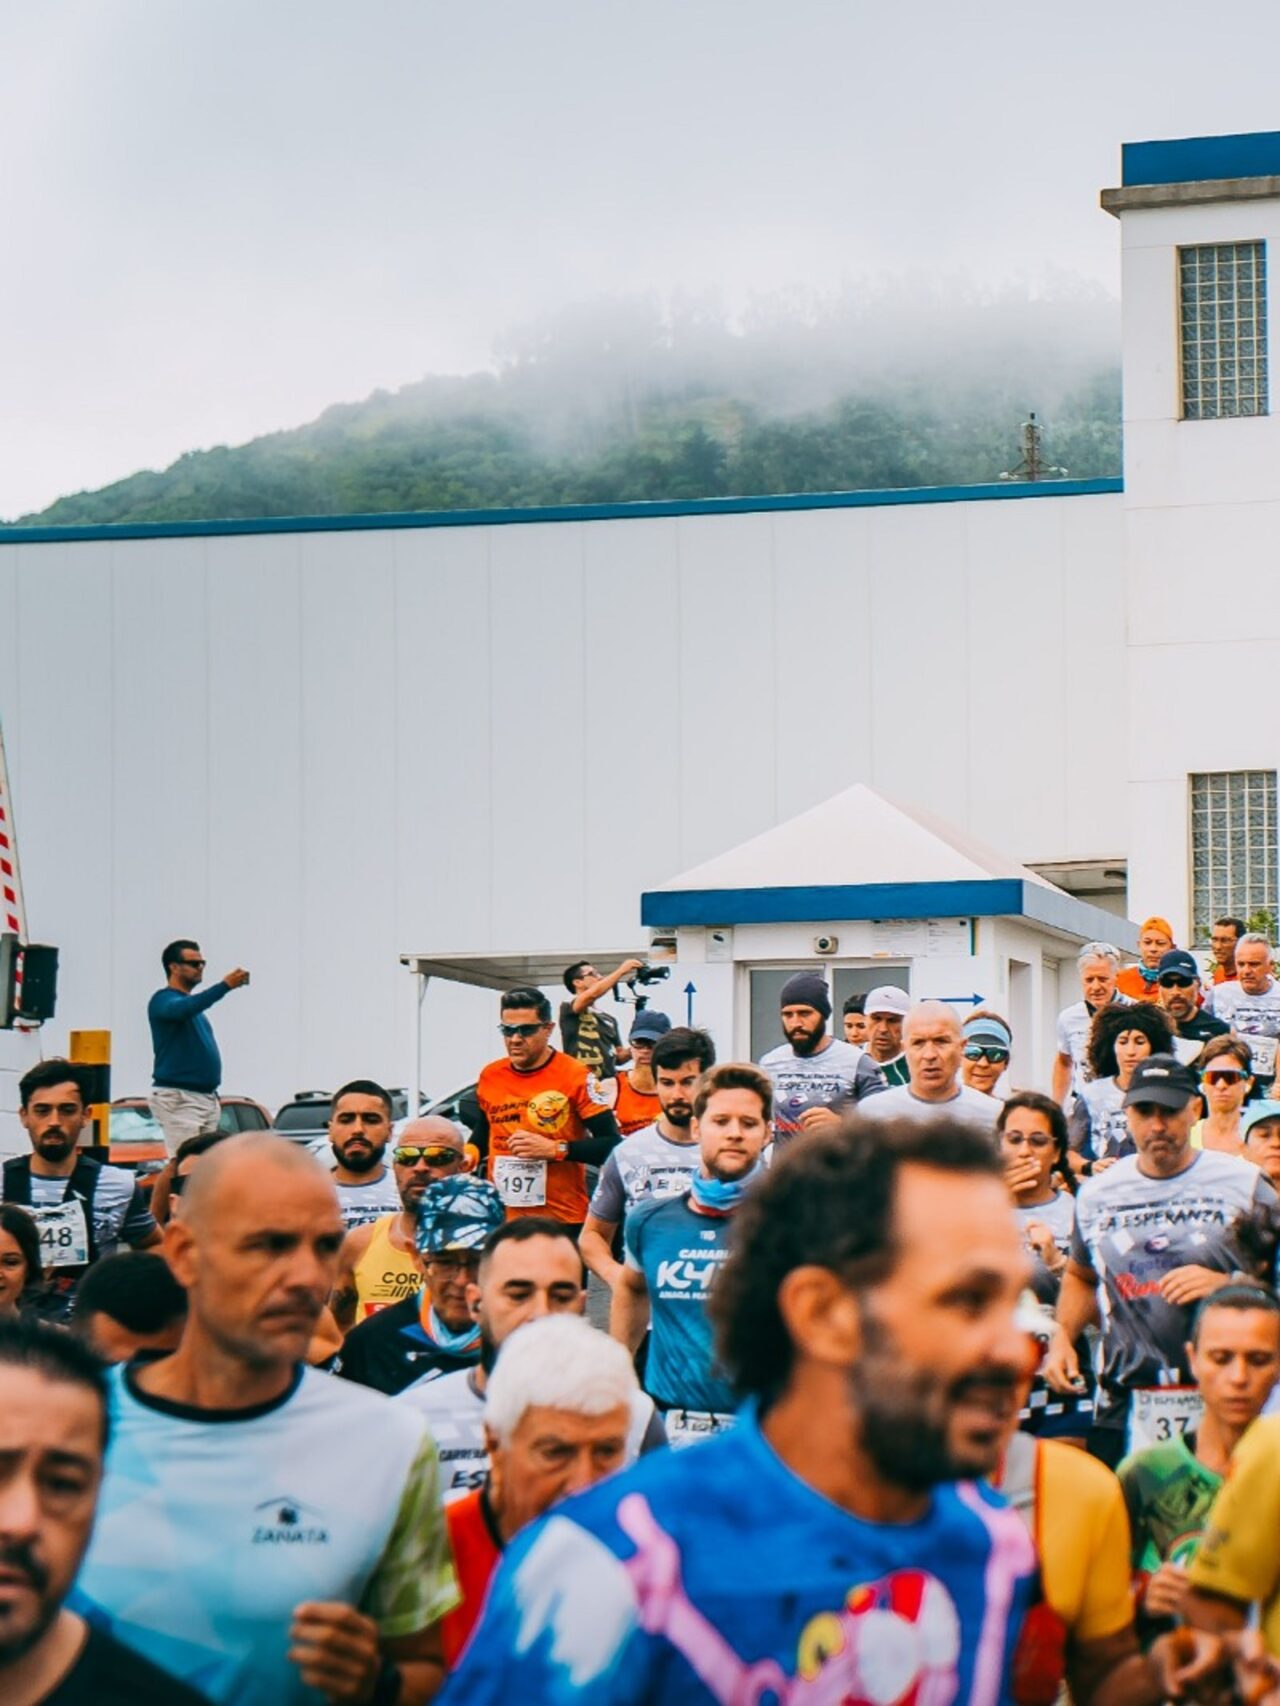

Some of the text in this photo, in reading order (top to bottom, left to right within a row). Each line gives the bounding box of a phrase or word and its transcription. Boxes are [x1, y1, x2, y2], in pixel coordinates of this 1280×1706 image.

[503, 1177, 535, 1193] 197
[1121, 1209, 1225, 1229] ESPERANZA
[656, 1260, 725, 1290] K4
